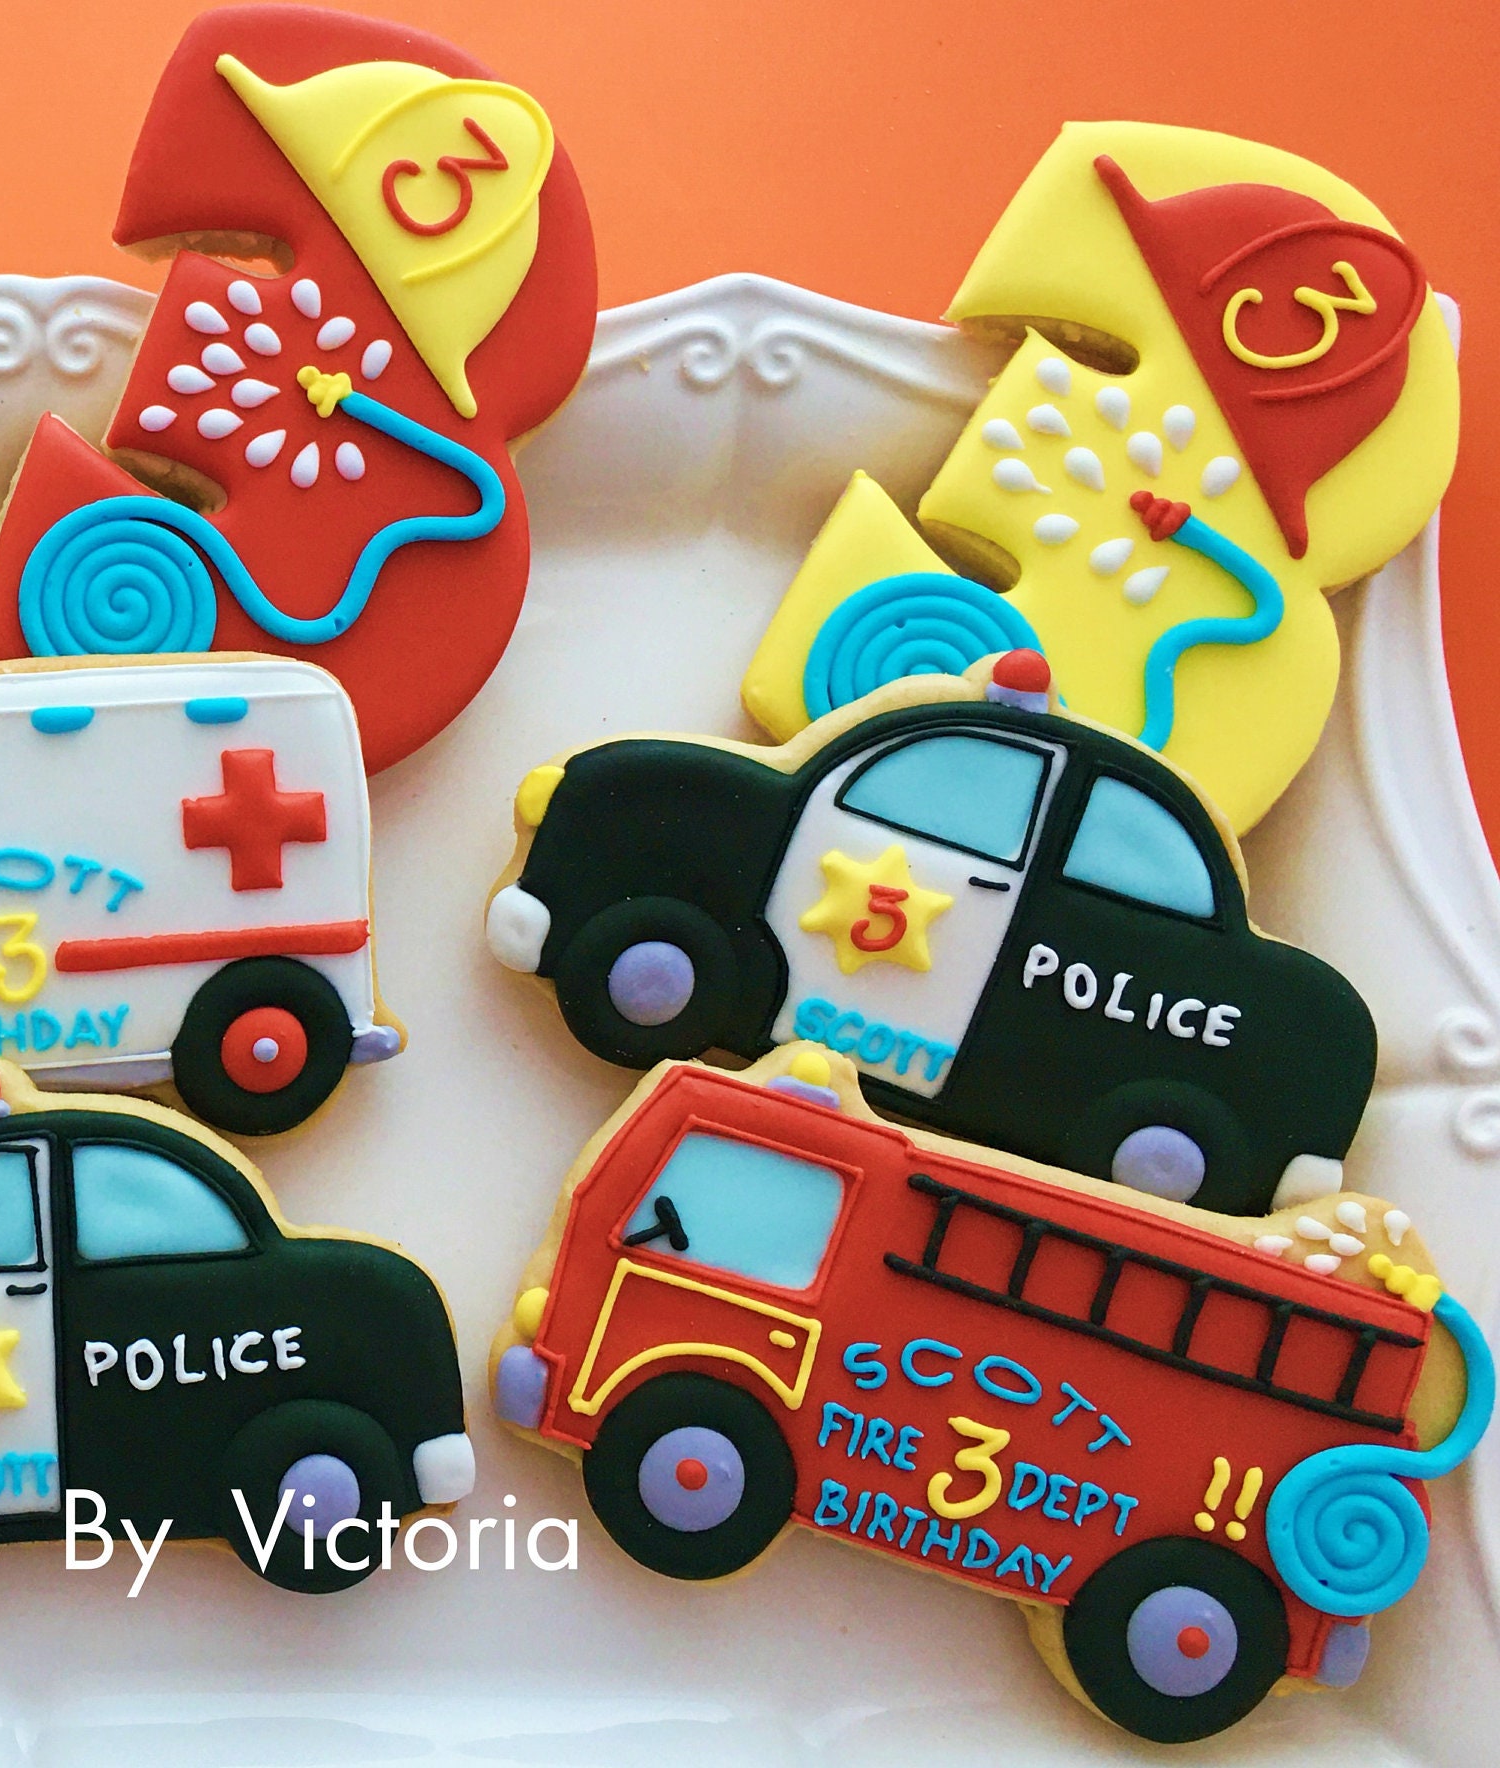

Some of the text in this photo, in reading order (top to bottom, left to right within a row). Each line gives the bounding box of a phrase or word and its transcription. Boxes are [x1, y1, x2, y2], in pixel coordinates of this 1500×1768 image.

[381, 116, 509, 237] 3
[1222, 260, 1377, 369] 3
[793, 997, 956, 1083] SCOTT
[1022, 942, 1242, 1047] POLICE
[84, 1326, 307, 1391] POLICE
[843, 1338, 1132, 1453] SCOTT
[817, 1402, 1139, 1536] FIRE 3 DEPT
[814, 1478, 1073, 1594] BIRTHDAY
